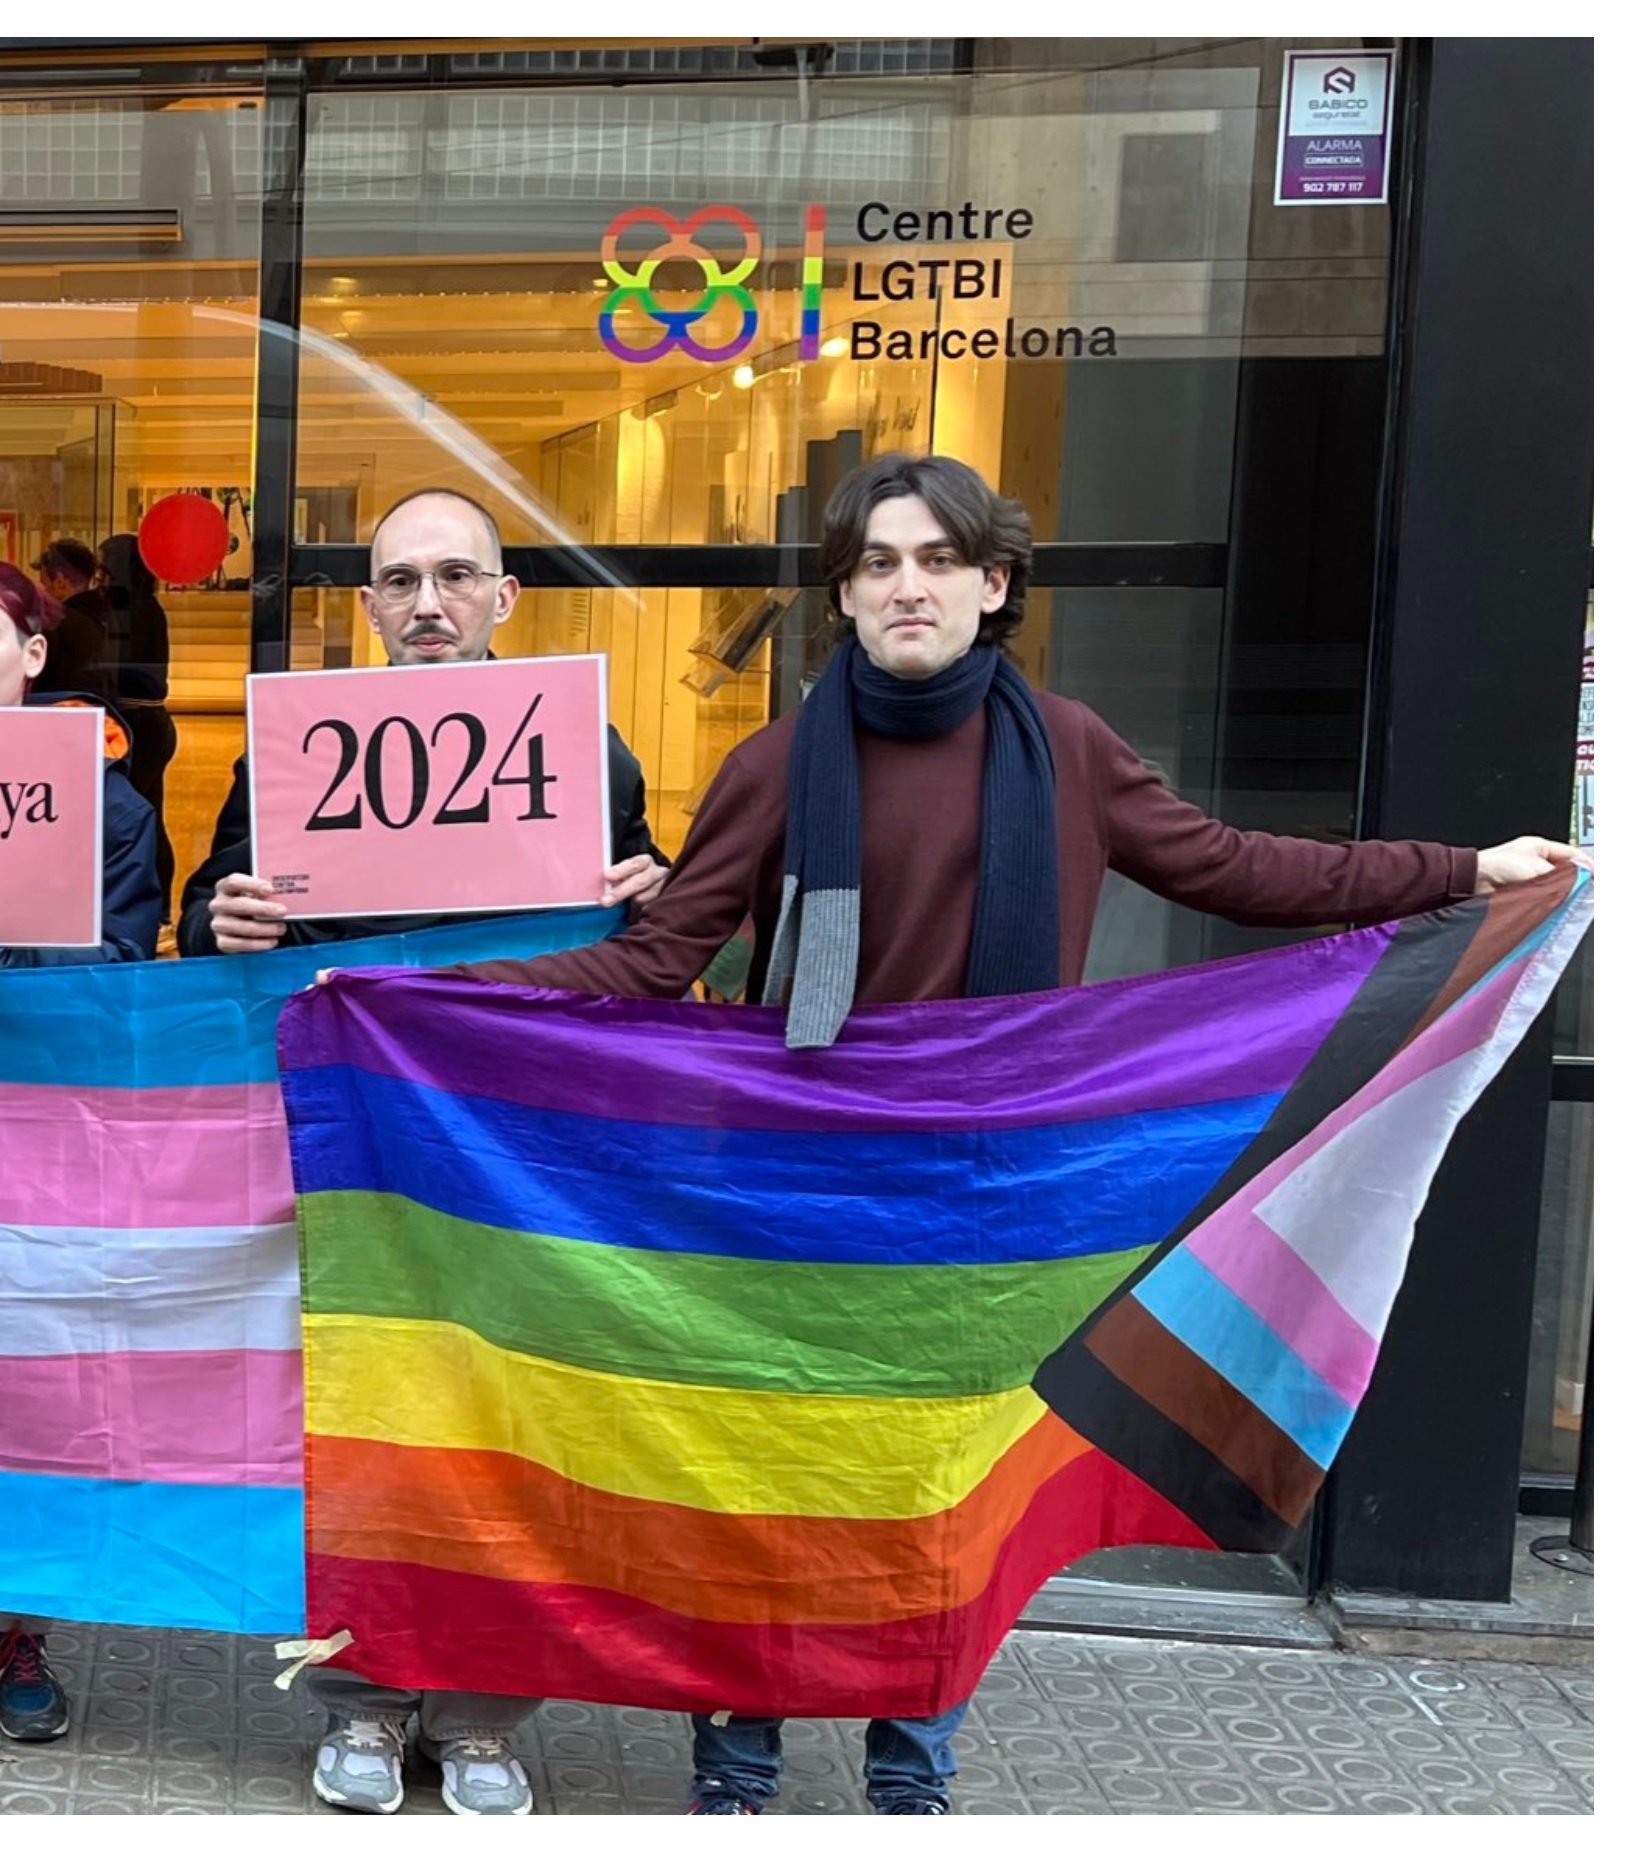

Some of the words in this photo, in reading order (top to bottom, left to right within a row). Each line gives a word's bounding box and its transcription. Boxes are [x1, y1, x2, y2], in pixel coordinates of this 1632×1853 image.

[1305, 156, 1362, 166] CONNECTADA
[1307, 140, 1363, 151] ALARMA
[1303, 182, 1324, 193] 902
[1326, 182, 1346, 193] 787
[1348, 182, 1364, 193] 117
[857, 202, 1033, 242] Centre
[853, 259, 1002, 301] LGTBI
[850, 318, 1117, 361] Barcelona
[302, 694, 558, 833] 2024
